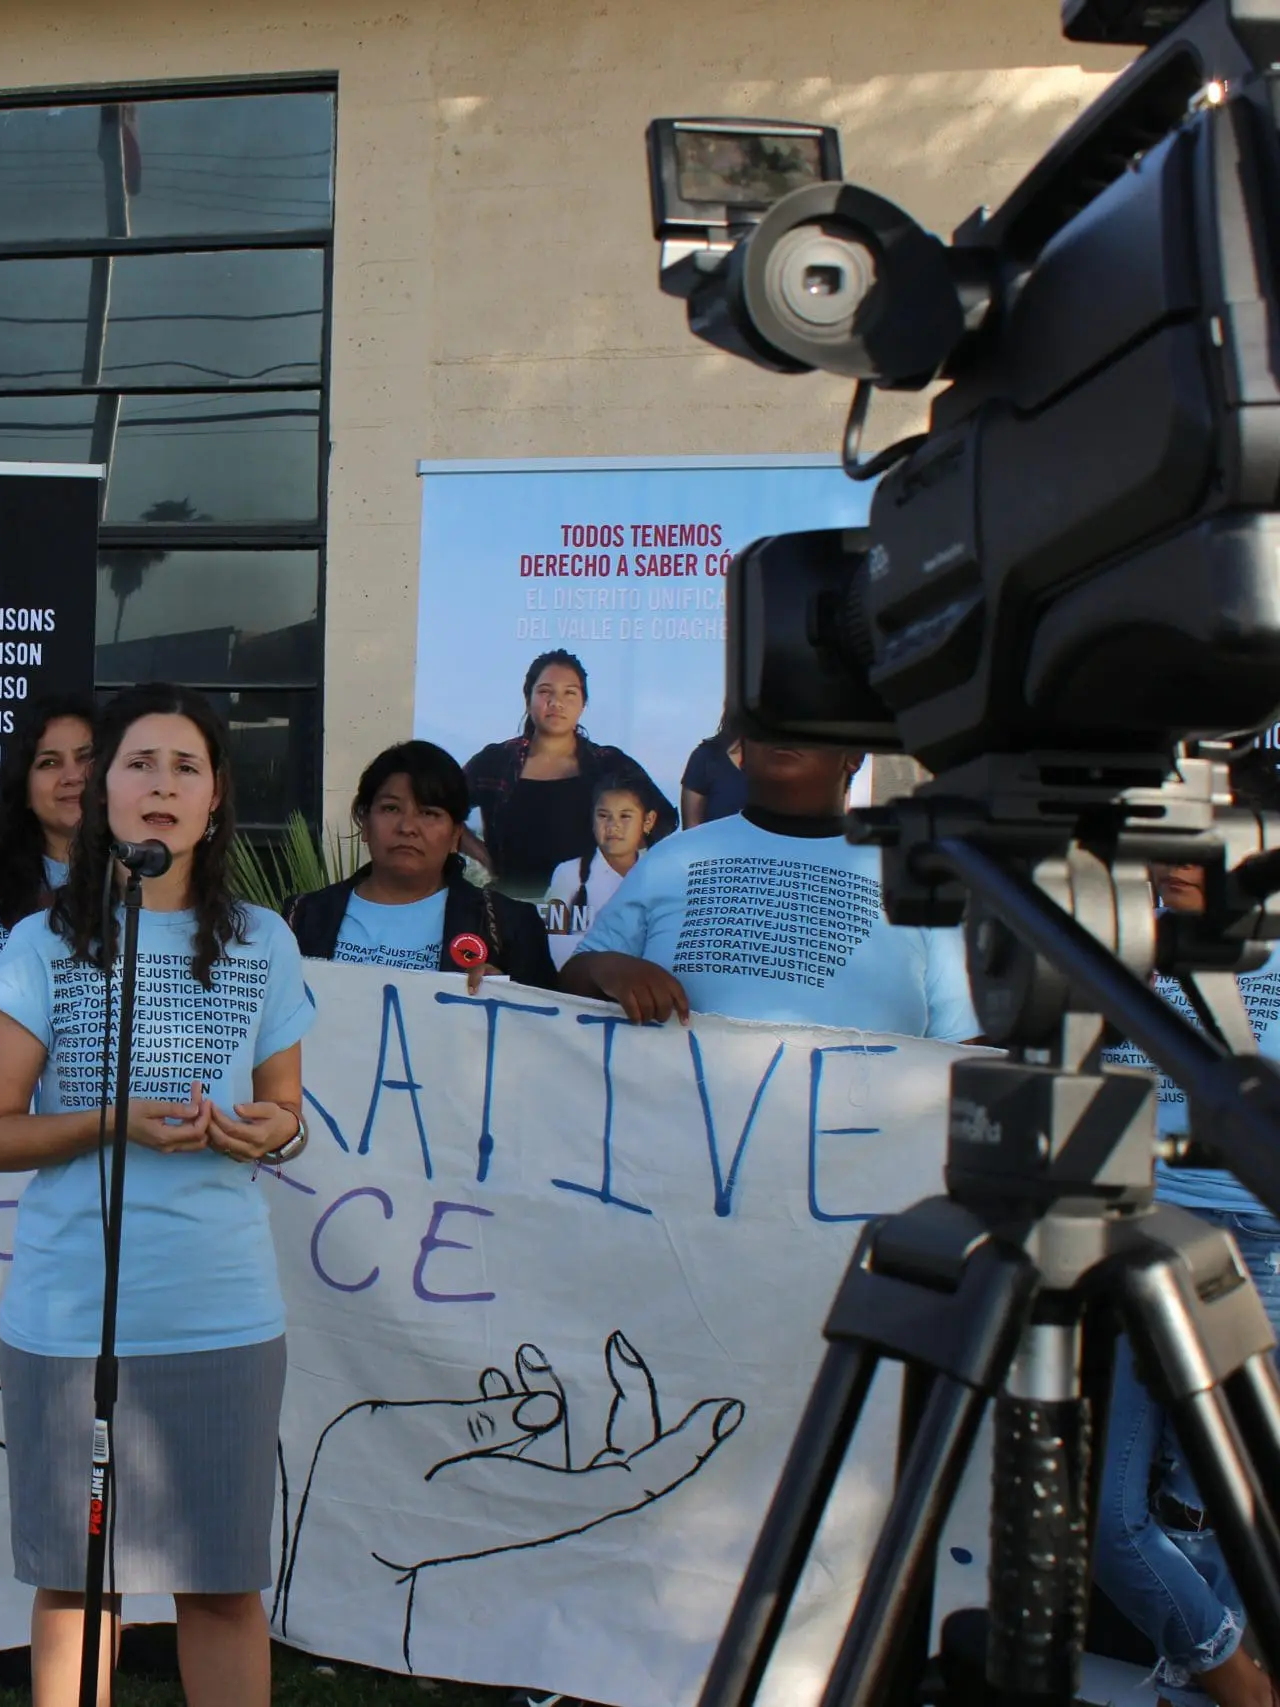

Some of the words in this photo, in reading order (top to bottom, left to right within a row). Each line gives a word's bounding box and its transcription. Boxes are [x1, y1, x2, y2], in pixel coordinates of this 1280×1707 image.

[561, 525, 624, 547] TODOS
[631, 524, 722, 547] TENEMOS
[520, 554, 610, 577] DERECHO
[617, 555, 628, 577] A
[635, 554, 698, 577] SABER
[526, 588, 548, 610] EL
[554, 588, 641, 610] DISTRITO
[649, 588, 726, 610] UNIFICA
[517, 618, 551, 639] DEL
[557, 618, 612, 640] VALLE
[621, 618, 644, 639] DE
[652, 617, 728, 640] COACHE
[672, 963, 825, 988] #RESTORATIVEJUSTICE
